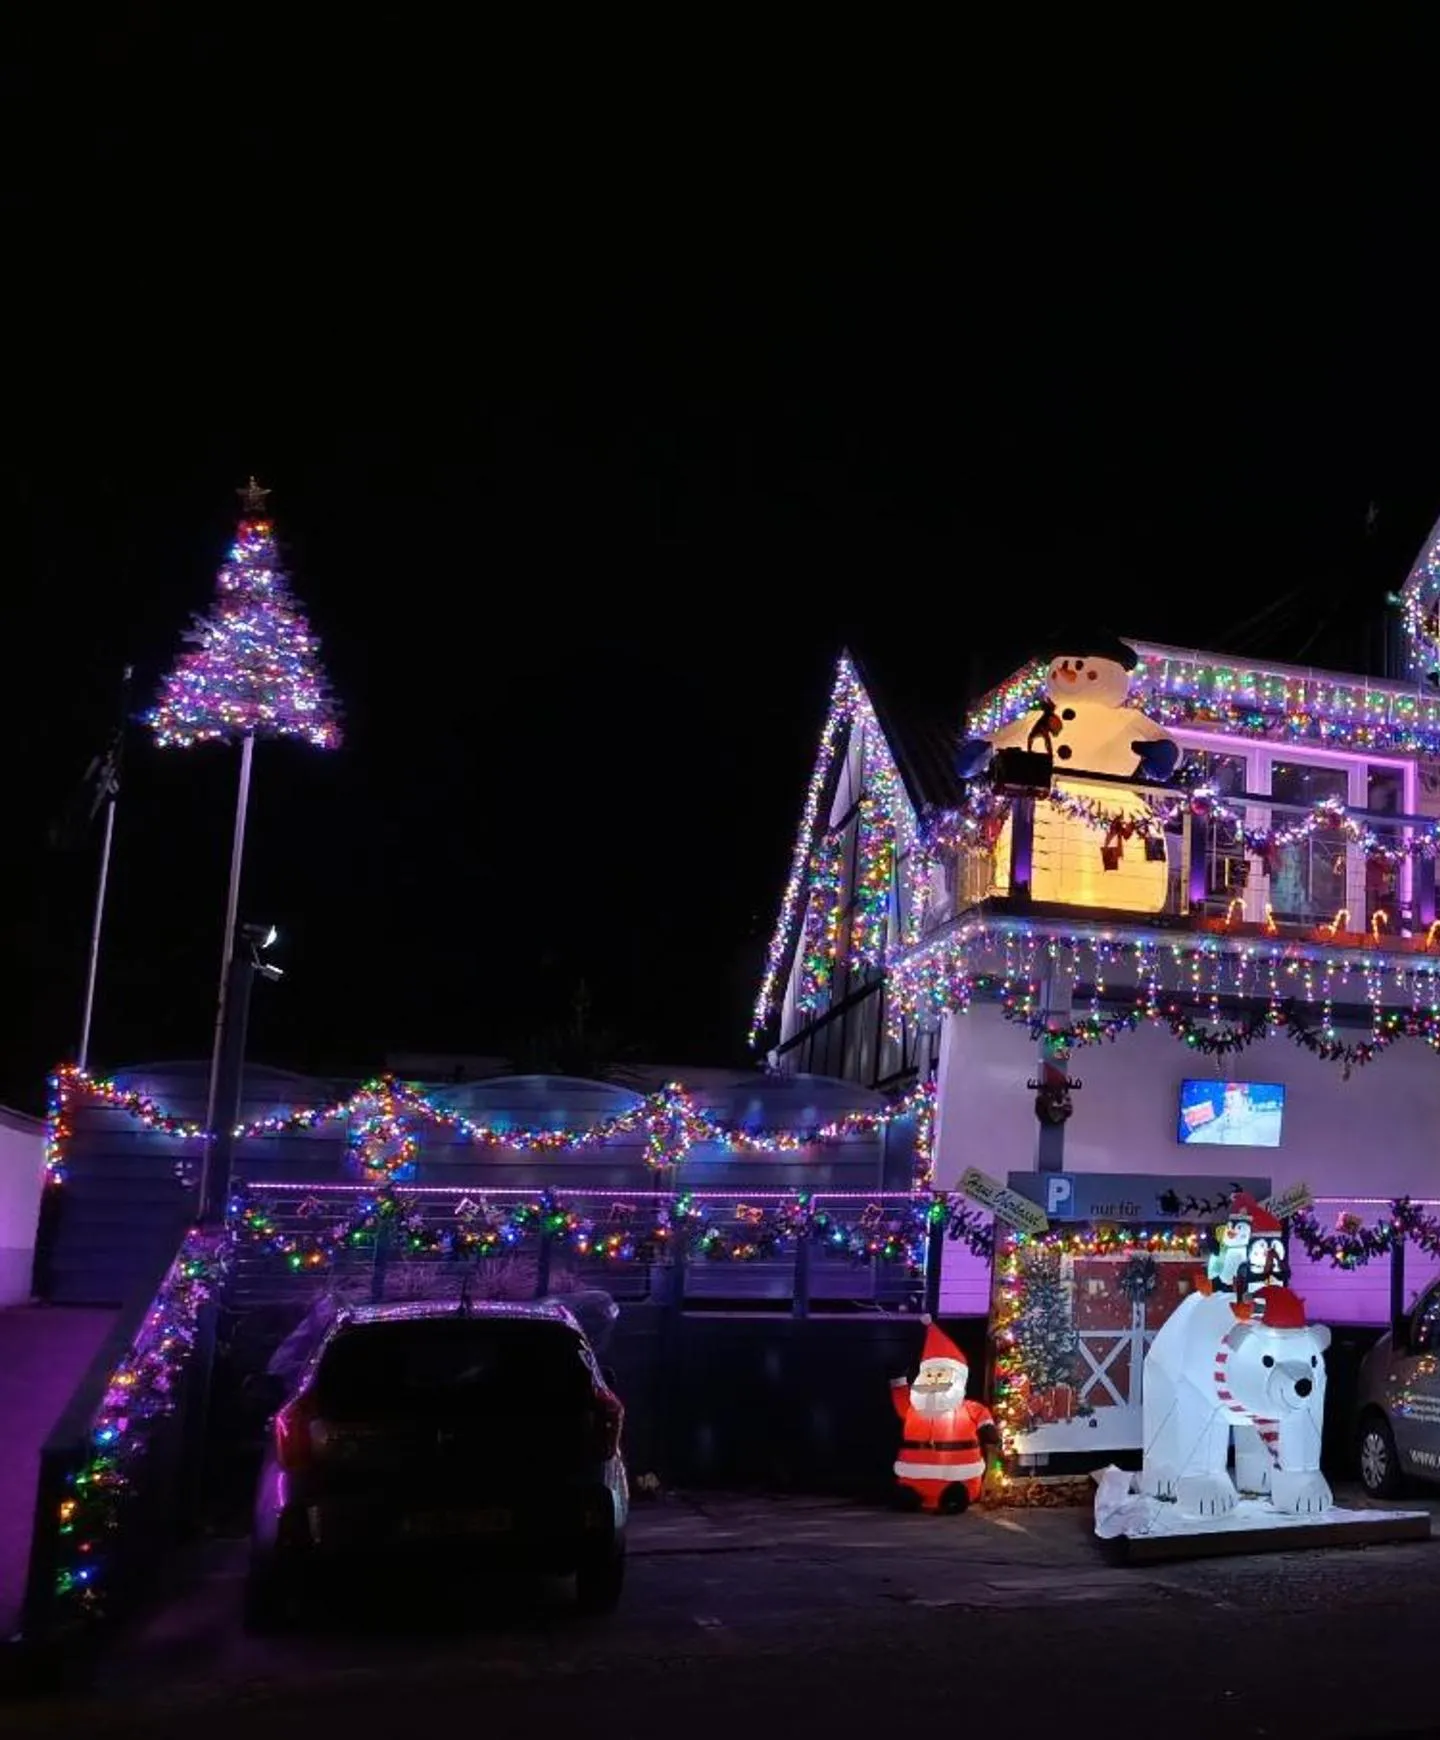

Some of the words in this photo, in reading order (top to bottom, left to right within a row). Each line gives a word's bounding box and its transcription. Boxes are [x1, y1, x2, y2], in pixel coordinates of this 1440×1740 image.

[1048, 1178, 1071, 1213] P
[1090, 1203, 1115, 1216] nur
[1119, 1199, 1142, 1217] für
